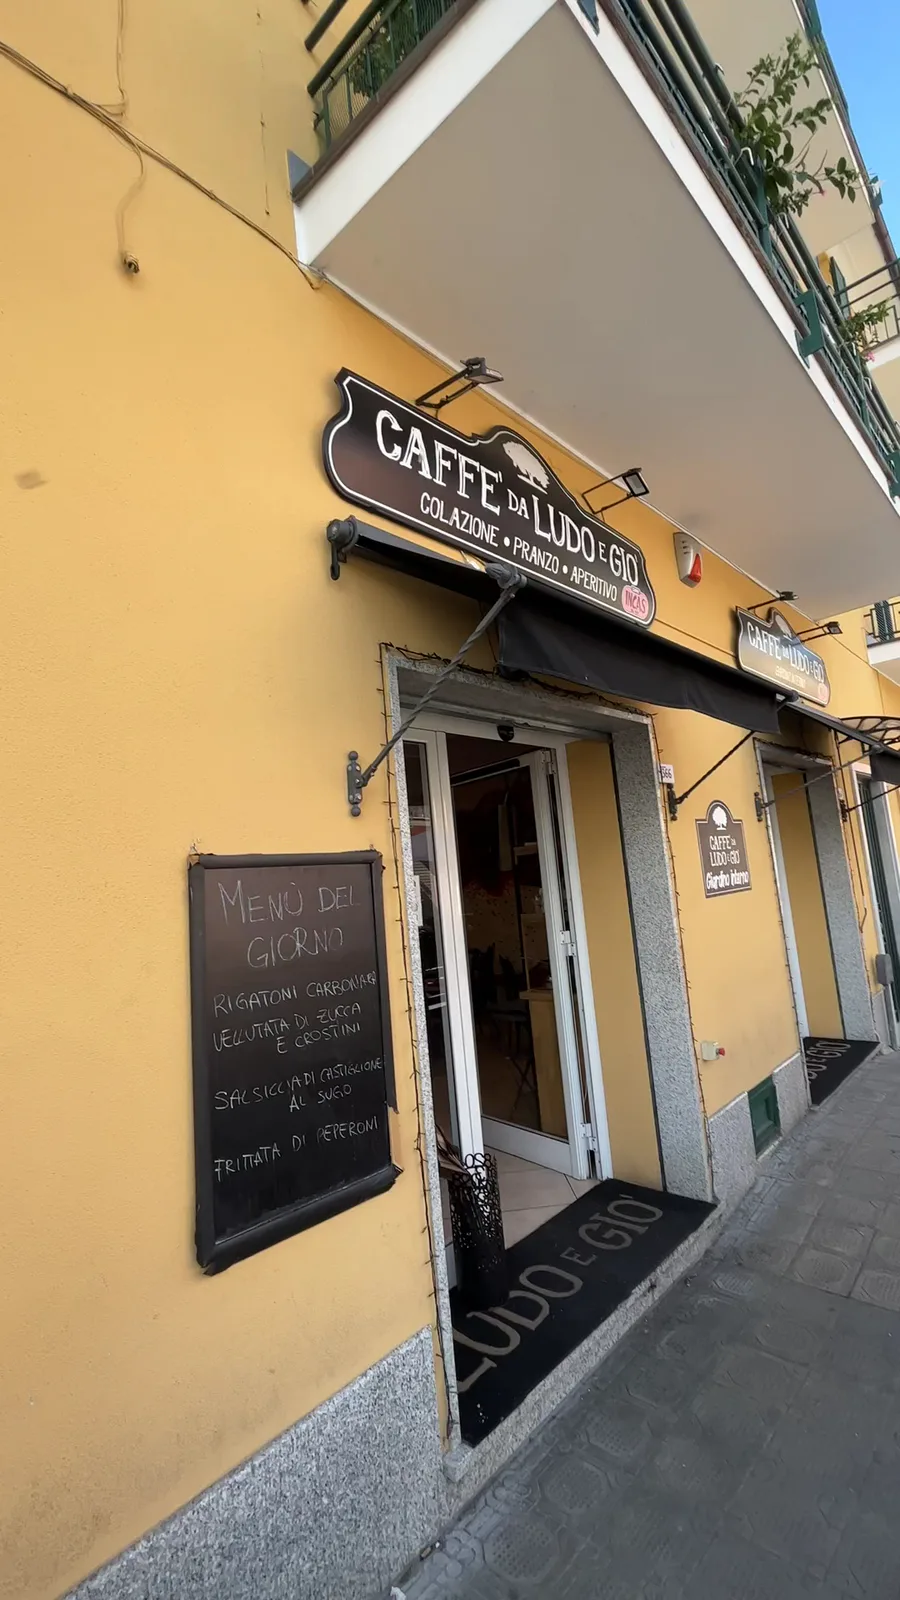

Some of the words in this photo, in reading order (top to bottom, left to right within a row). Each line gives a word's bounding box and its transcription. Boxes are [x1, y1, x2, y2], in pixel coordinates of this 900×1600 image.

[420, 492, 500, 548] COLAZIONE
[513, 536, 560, 574] PRANZO
[570, 566, 617, 602] APERITIVO
[507, 489, 529, 519] DA
[532, 495, 596, 563] LUDO
[598, 540, 607, 562] E
[317, 885, 358, 913] DEL
[247, 926, 343, 969] GIORNO
[213, 985, 298, 1018] RIGATONI
[213, 1018, 290, 1052] VELLUTATA
[294, 1013, 309, 1030] DI
[316, 1002, 361, 1023] ZUCCA
[276, 1036, 288, 1054] E
[294, 1022, 360, 1048] CROSTINI
[214, 1075, 302, 1110] SALSICCIA
[304, 1071, 316, 1086] DI
[320, 1058, 382, 1083] CASTIGLIONE
[289, 1094, 306, 1112] AL
[317, 1084, 352, 1103] SUGO
[214, 1142, 281, 1182] FRITTATA
[292, 1135, 306, 1152] DI
[316, 1116, 378, 1142] PEPERONI
[560, 1246, 597, 1266] E
